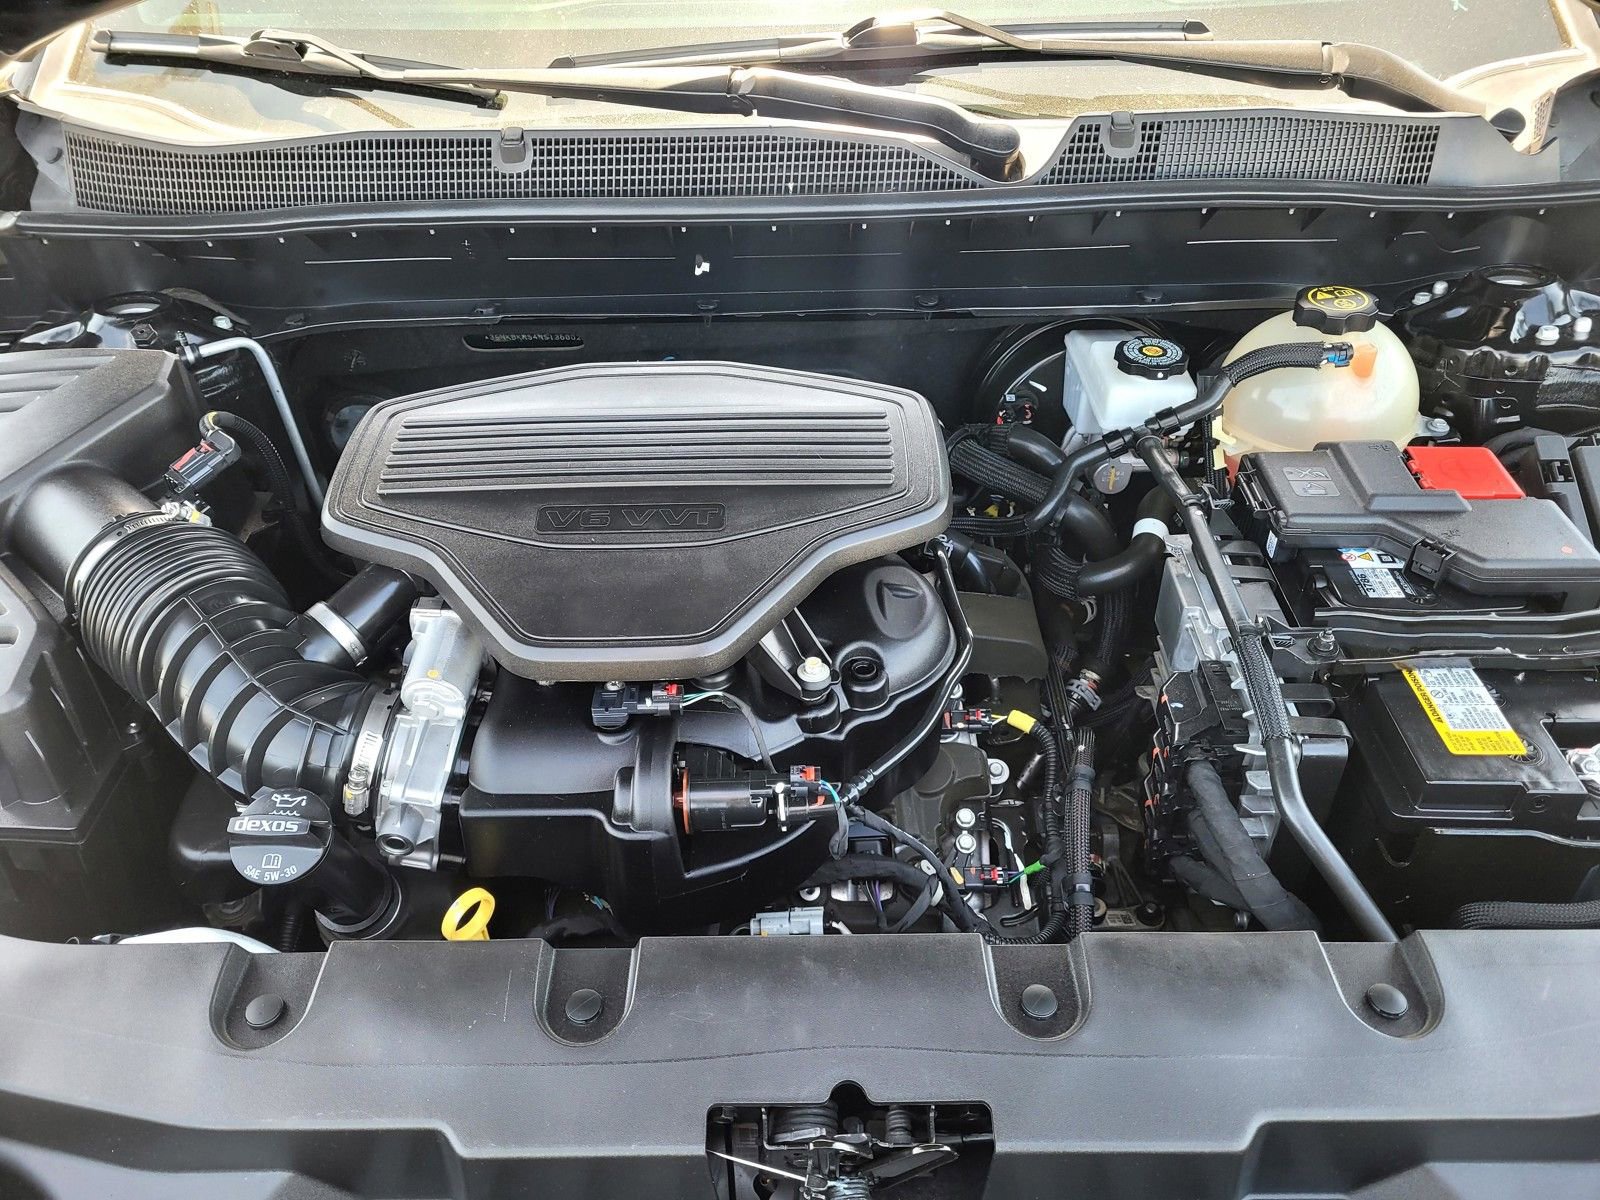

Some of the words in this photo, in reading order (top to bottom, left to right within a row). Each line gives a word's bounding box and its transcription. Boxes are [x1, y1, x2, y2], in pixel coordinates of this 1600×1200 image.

[545, 509, 611, 527] V6
[621, 507, 720, 526] VVT
[1357, 573, 1376, 593] 3786
[234, 816, 300, 832] dexos
[243, 865, 261, 880] SAE
[263, 865, 298, 881] 5W-30
